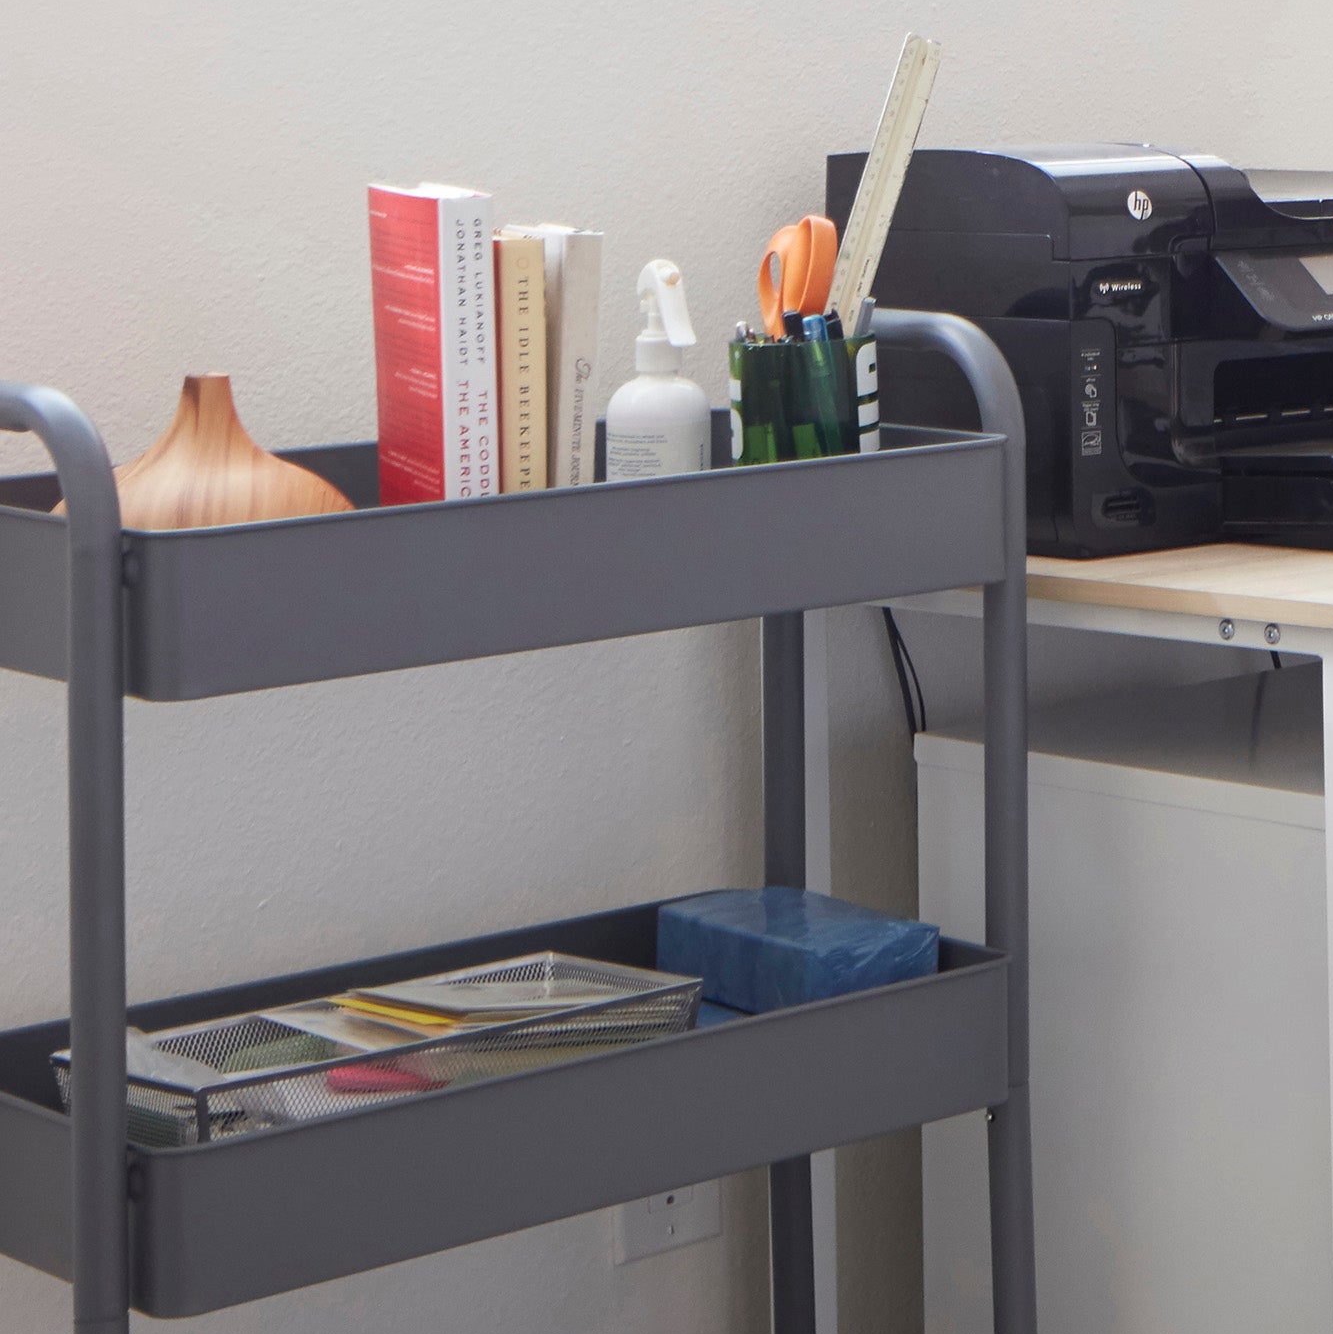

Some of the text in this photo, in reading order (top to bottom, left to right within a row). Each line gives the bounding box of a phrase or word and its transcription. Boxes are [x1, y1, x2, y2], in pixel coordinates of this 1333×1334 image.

[1132, 190, 1150, 220] hp
[456, 218, 469, 367] JONATHAN HAIDT
[473, 218, 485, 365] GREG LUKIANOFF
[1110, 282, 1142, 292] Wireless
[458, 380, 471, 499] THE AMERIC
[477, 391, 489, 427] THE
[517, 278, 531, 491] THE IDLE BEEKEEPE
